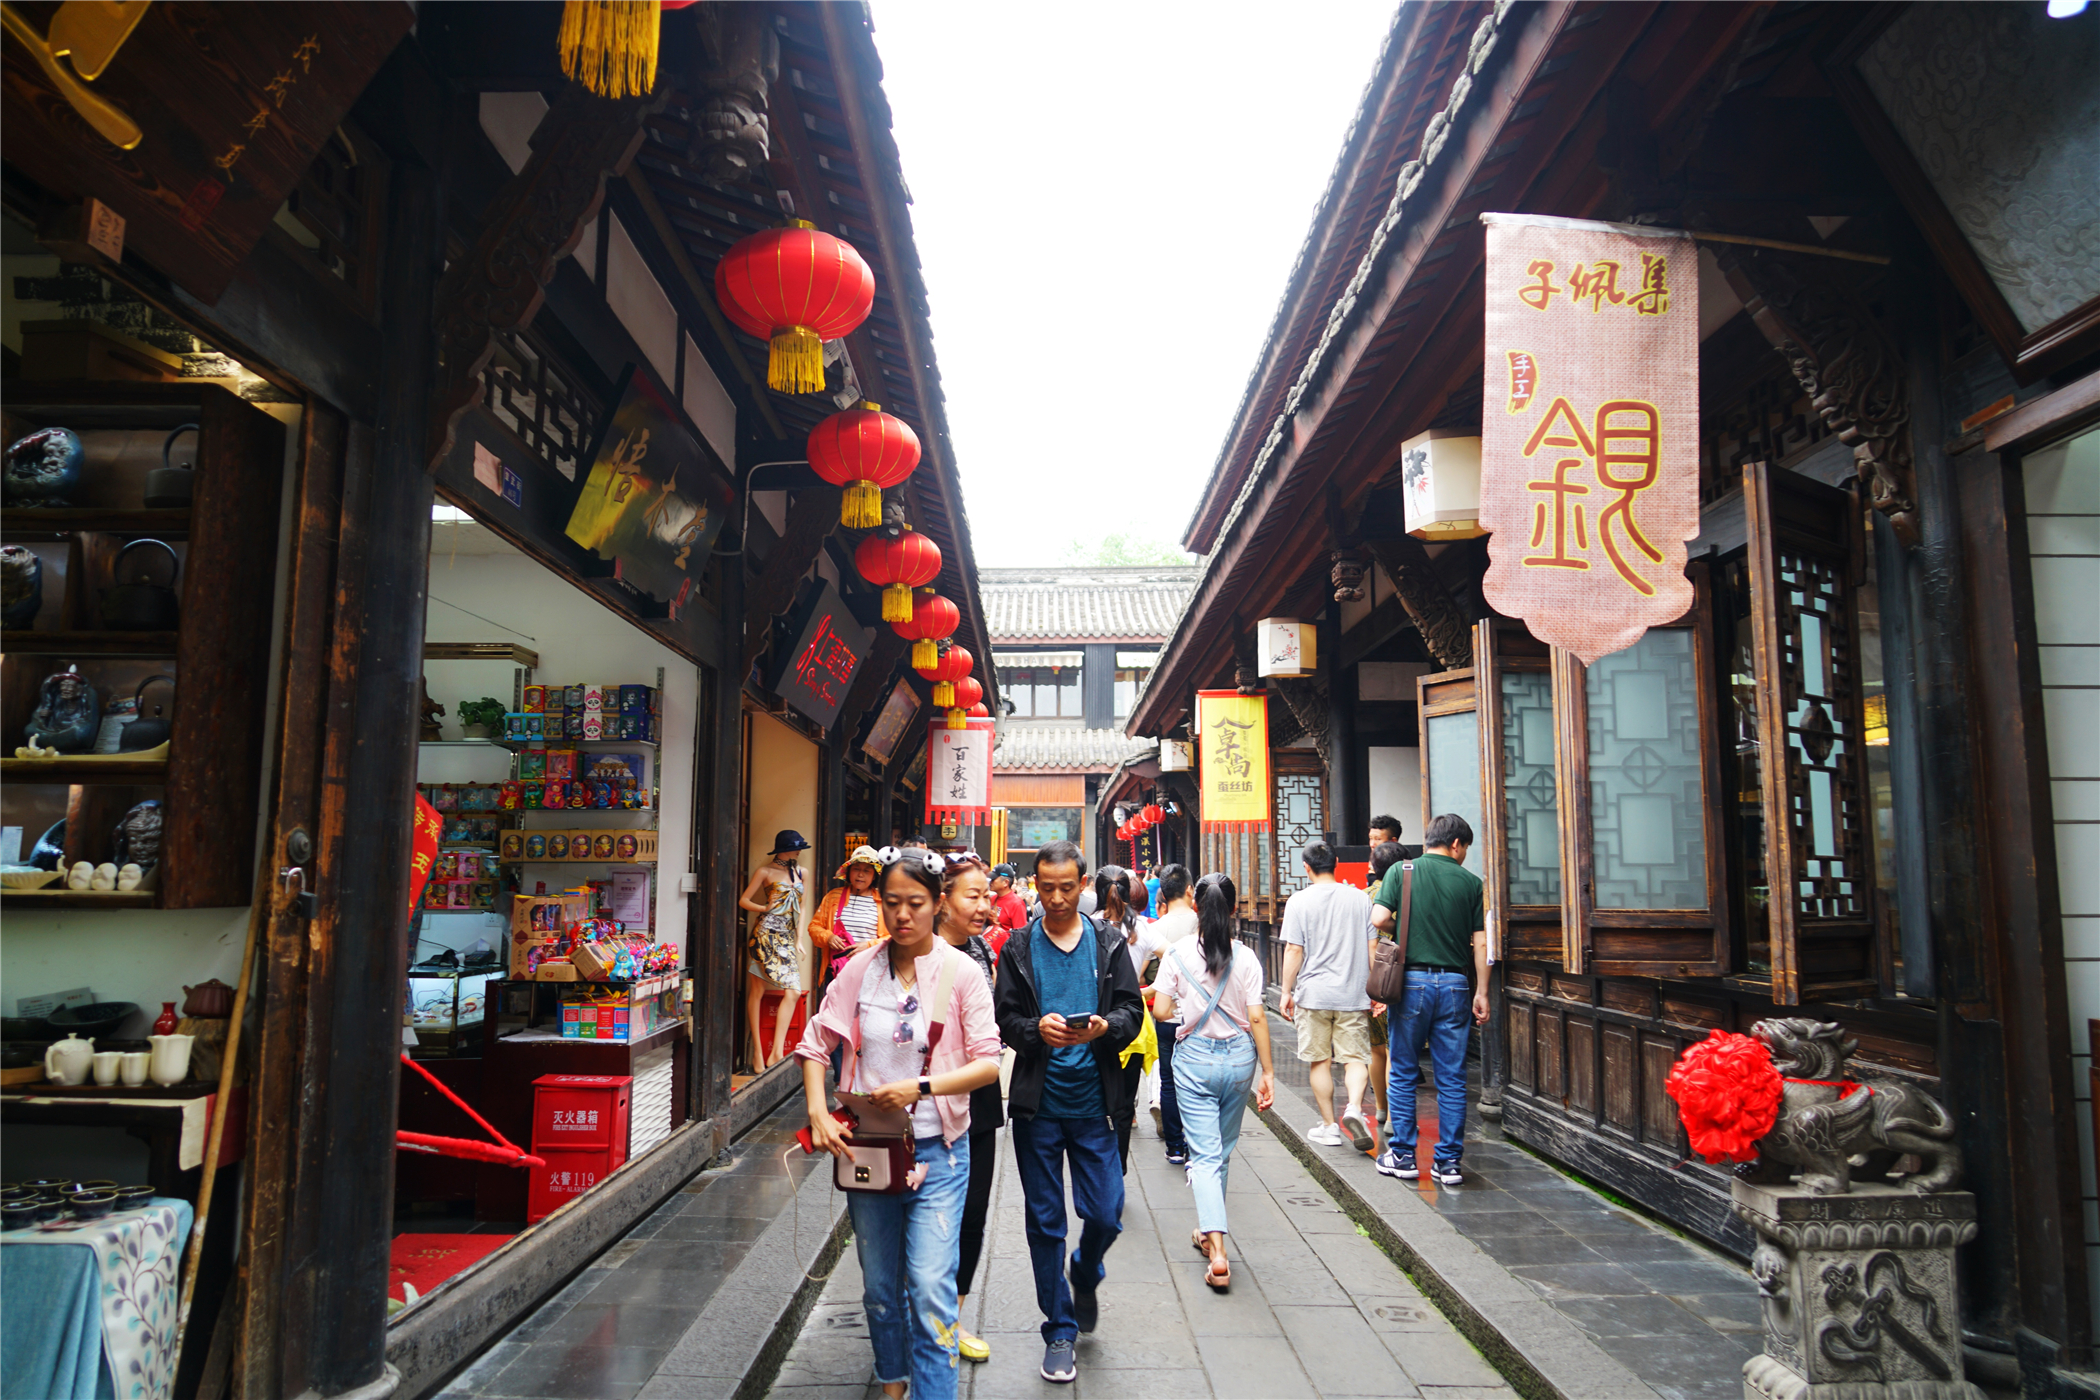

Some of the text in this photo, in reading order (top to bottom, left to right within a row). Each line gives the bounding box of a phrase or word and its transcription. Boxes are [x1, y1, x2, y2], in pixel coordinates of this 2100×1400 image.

[1518, 252, 1670, 315] 子佩集
[1511, 353, 1531, 400] 手工
[1017, 656, 1045, 665] SHAN
[950, 745, 970, 800] 百家姓
[1217, 780, 1253, 793] 蚕丝坊
[942, 826, 955, 836] 李
[552, 1109, 599, 1125] 灭火器箱
[1810, 1198, 1945, 1220] 財源廣進
